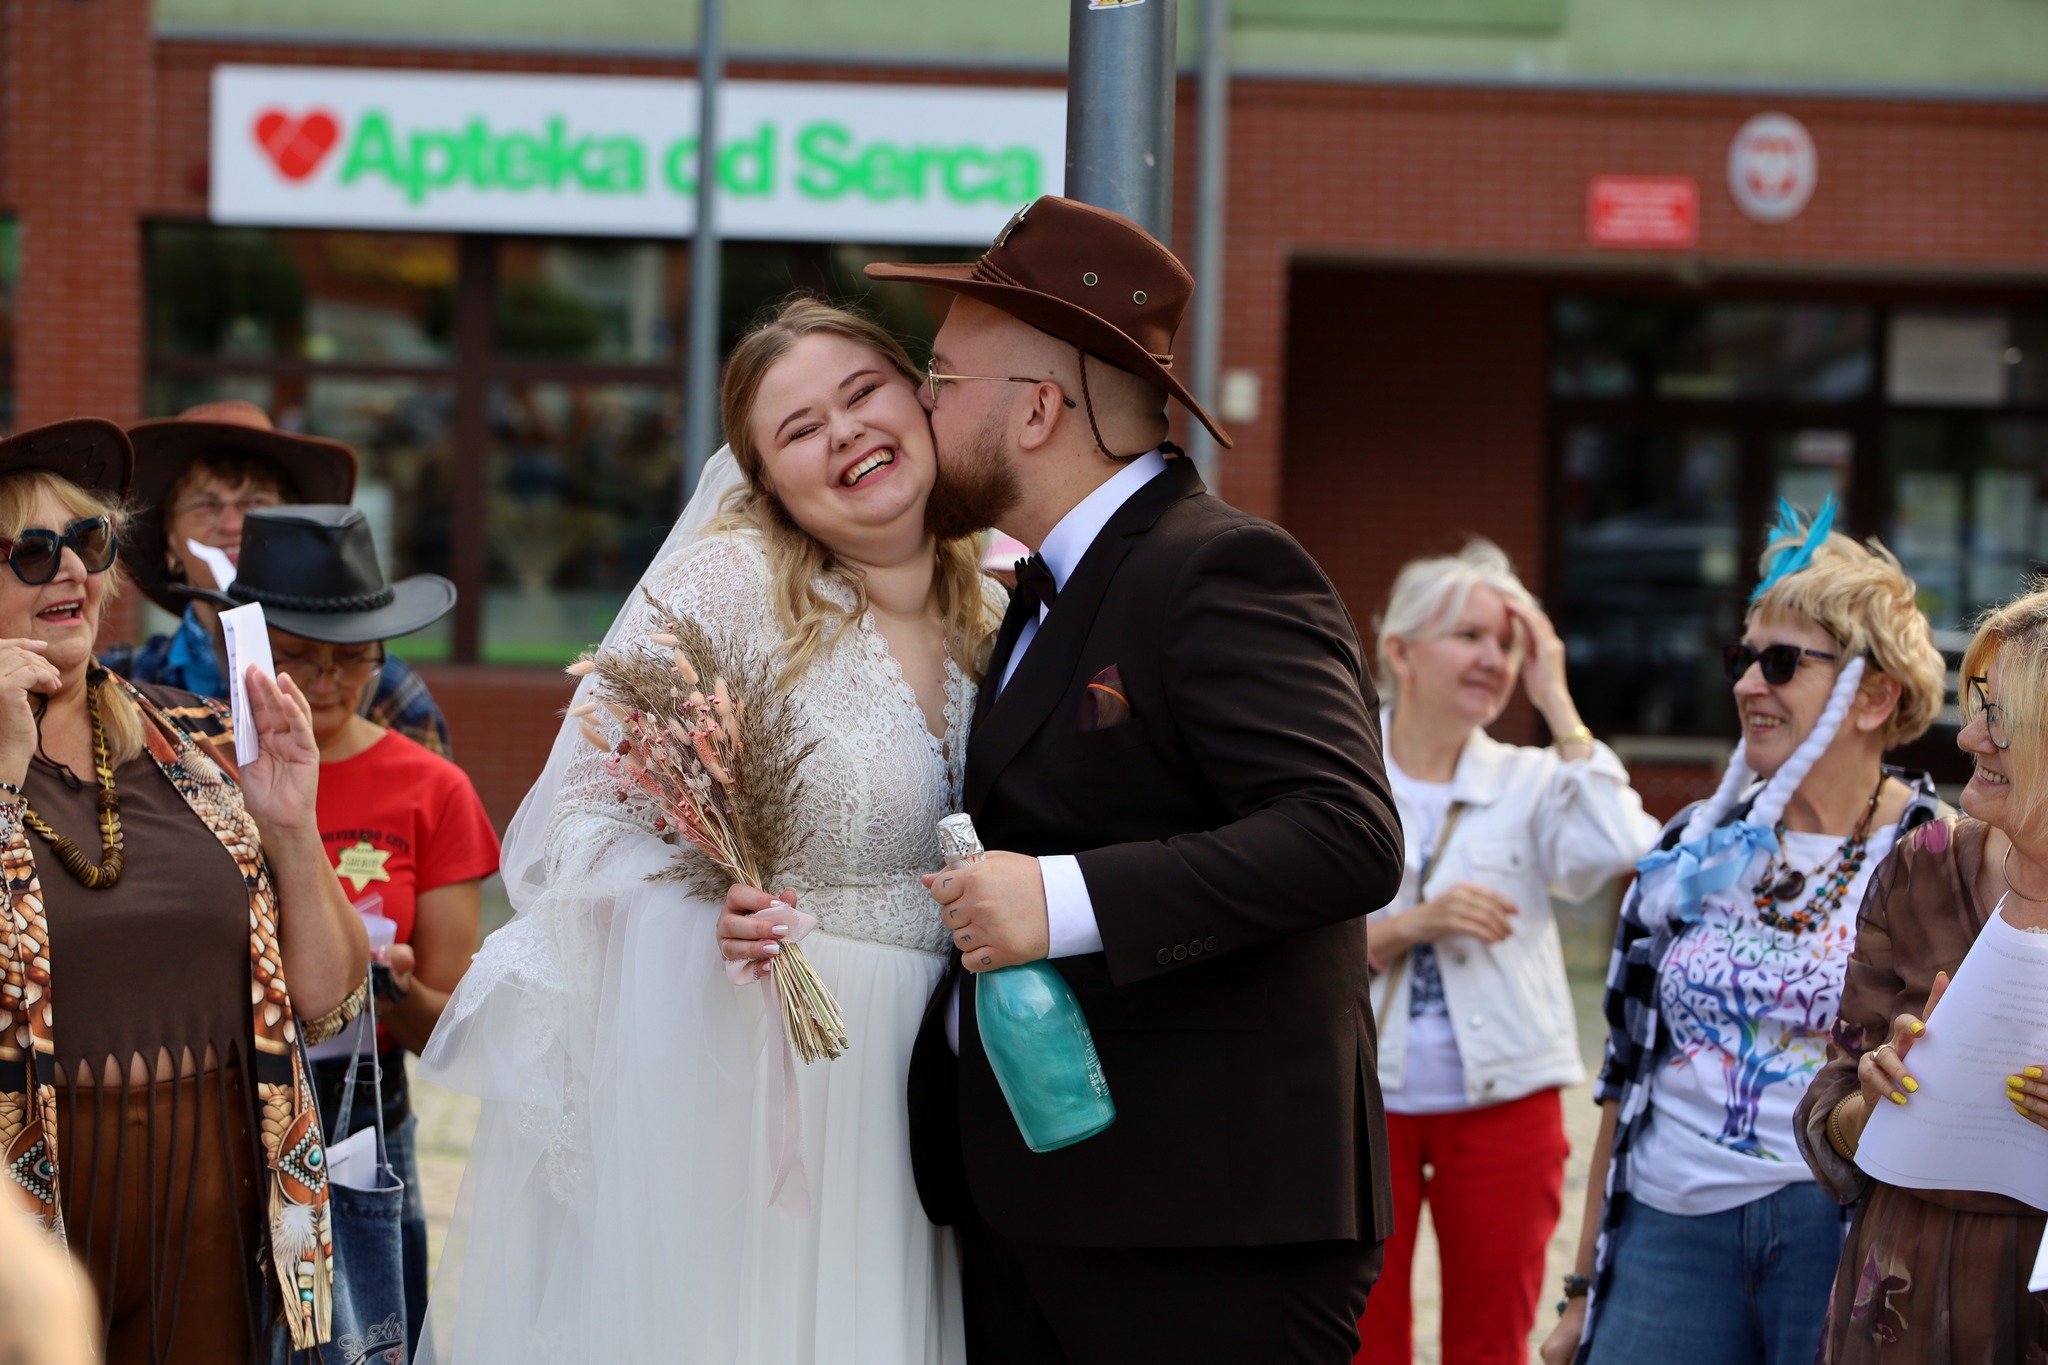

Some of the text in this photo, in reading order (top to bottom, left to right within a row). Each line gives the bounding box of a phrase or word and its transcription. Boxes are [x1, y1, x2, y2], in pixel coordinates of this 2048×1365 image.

[339, 108, 1042, 204] Apteka od Serca
